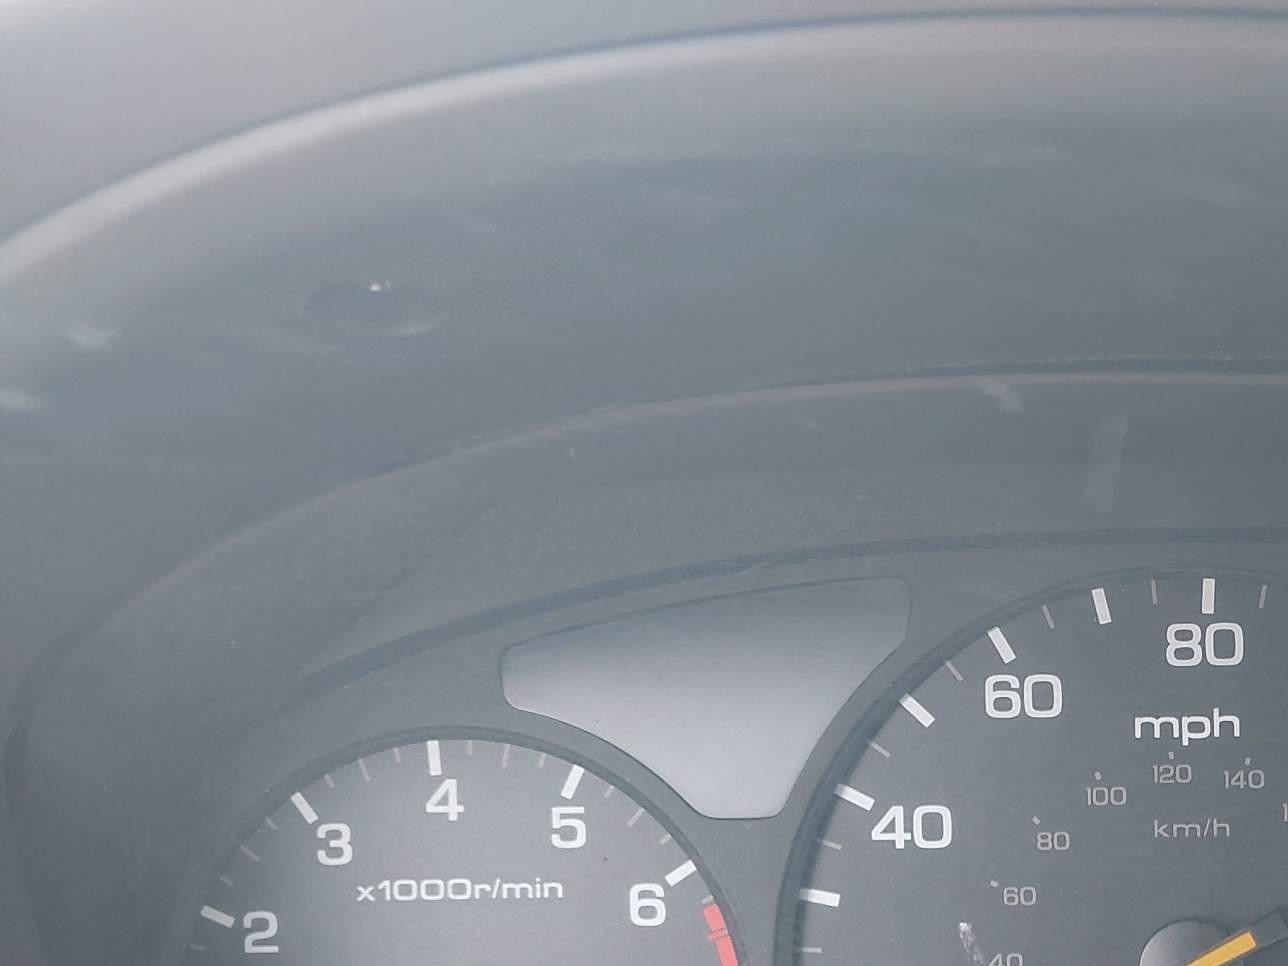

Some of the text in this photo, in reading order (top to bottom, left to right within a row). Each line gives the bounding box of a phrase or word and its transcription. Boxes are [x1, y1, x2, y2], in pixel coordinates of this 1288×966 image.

[1166, 623, 1244, 667] 80
[984, 674, 1062, 719] 60
[1134, 708, 1240, 746] mph
[1153, 764, 1192, 784] 120
[1224, 770, 1265, 789] 140
[426, 779, 464, 821] 4
[1086, 787, 1127, 806] 100
[317, 825, 353, 865] 3
[551, 807, 586, 848] 5
[871, 805, 952, 849] 40
[1036, 832, 1070, 850] 80
[1154, 818, 1230, 838] km/h
[356, 877, 563, 902] x1000r/min
[629, 884, 666, 926] 6
[1003, 887, 1037, 906] 60
[243, 911, 279, 953] 2
